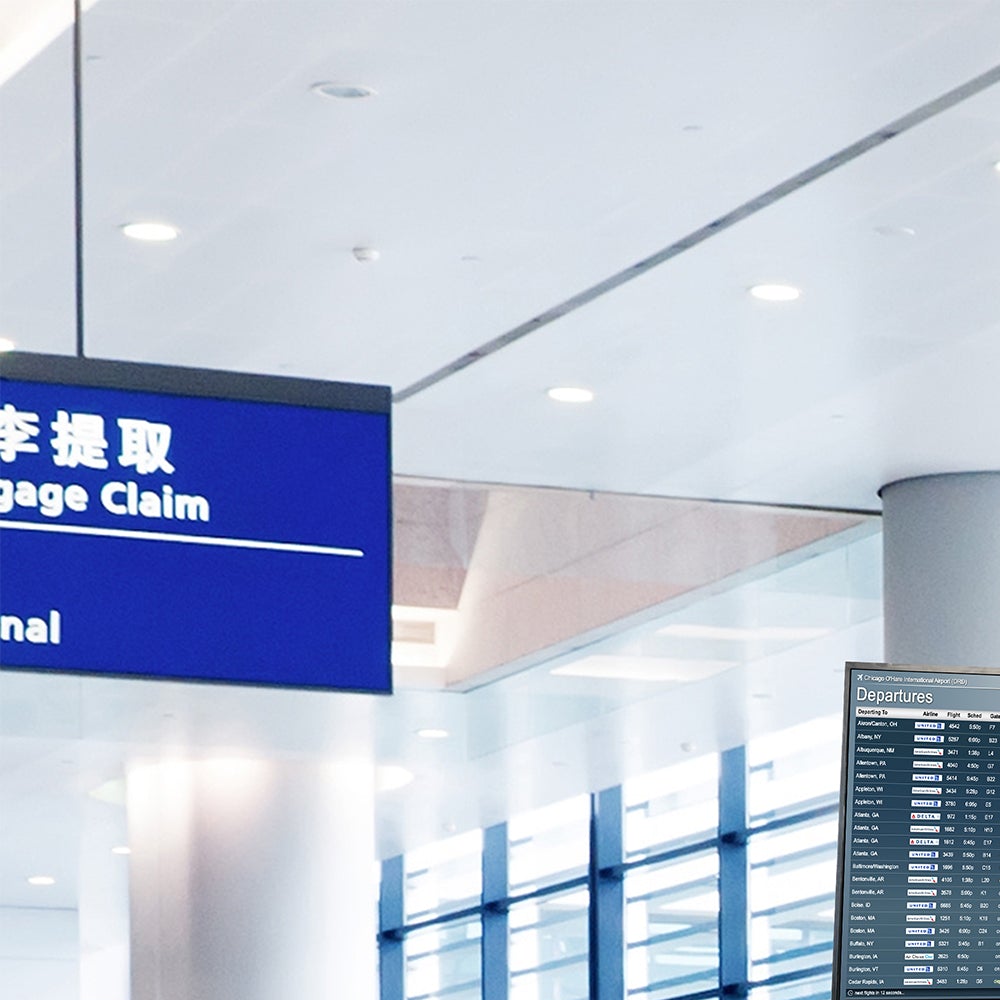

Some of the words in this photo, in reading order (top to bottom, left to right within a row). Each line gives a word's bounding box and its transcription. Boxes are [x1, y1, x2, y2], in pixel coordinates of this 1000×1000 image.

[100, 481, 210, 522] Claim
[0, 609, 61, 645] nal
[856, 687, 934, 706] Departures
[858, 708, 882, 716] Departing
[947, 711, 961, 719] Flight
